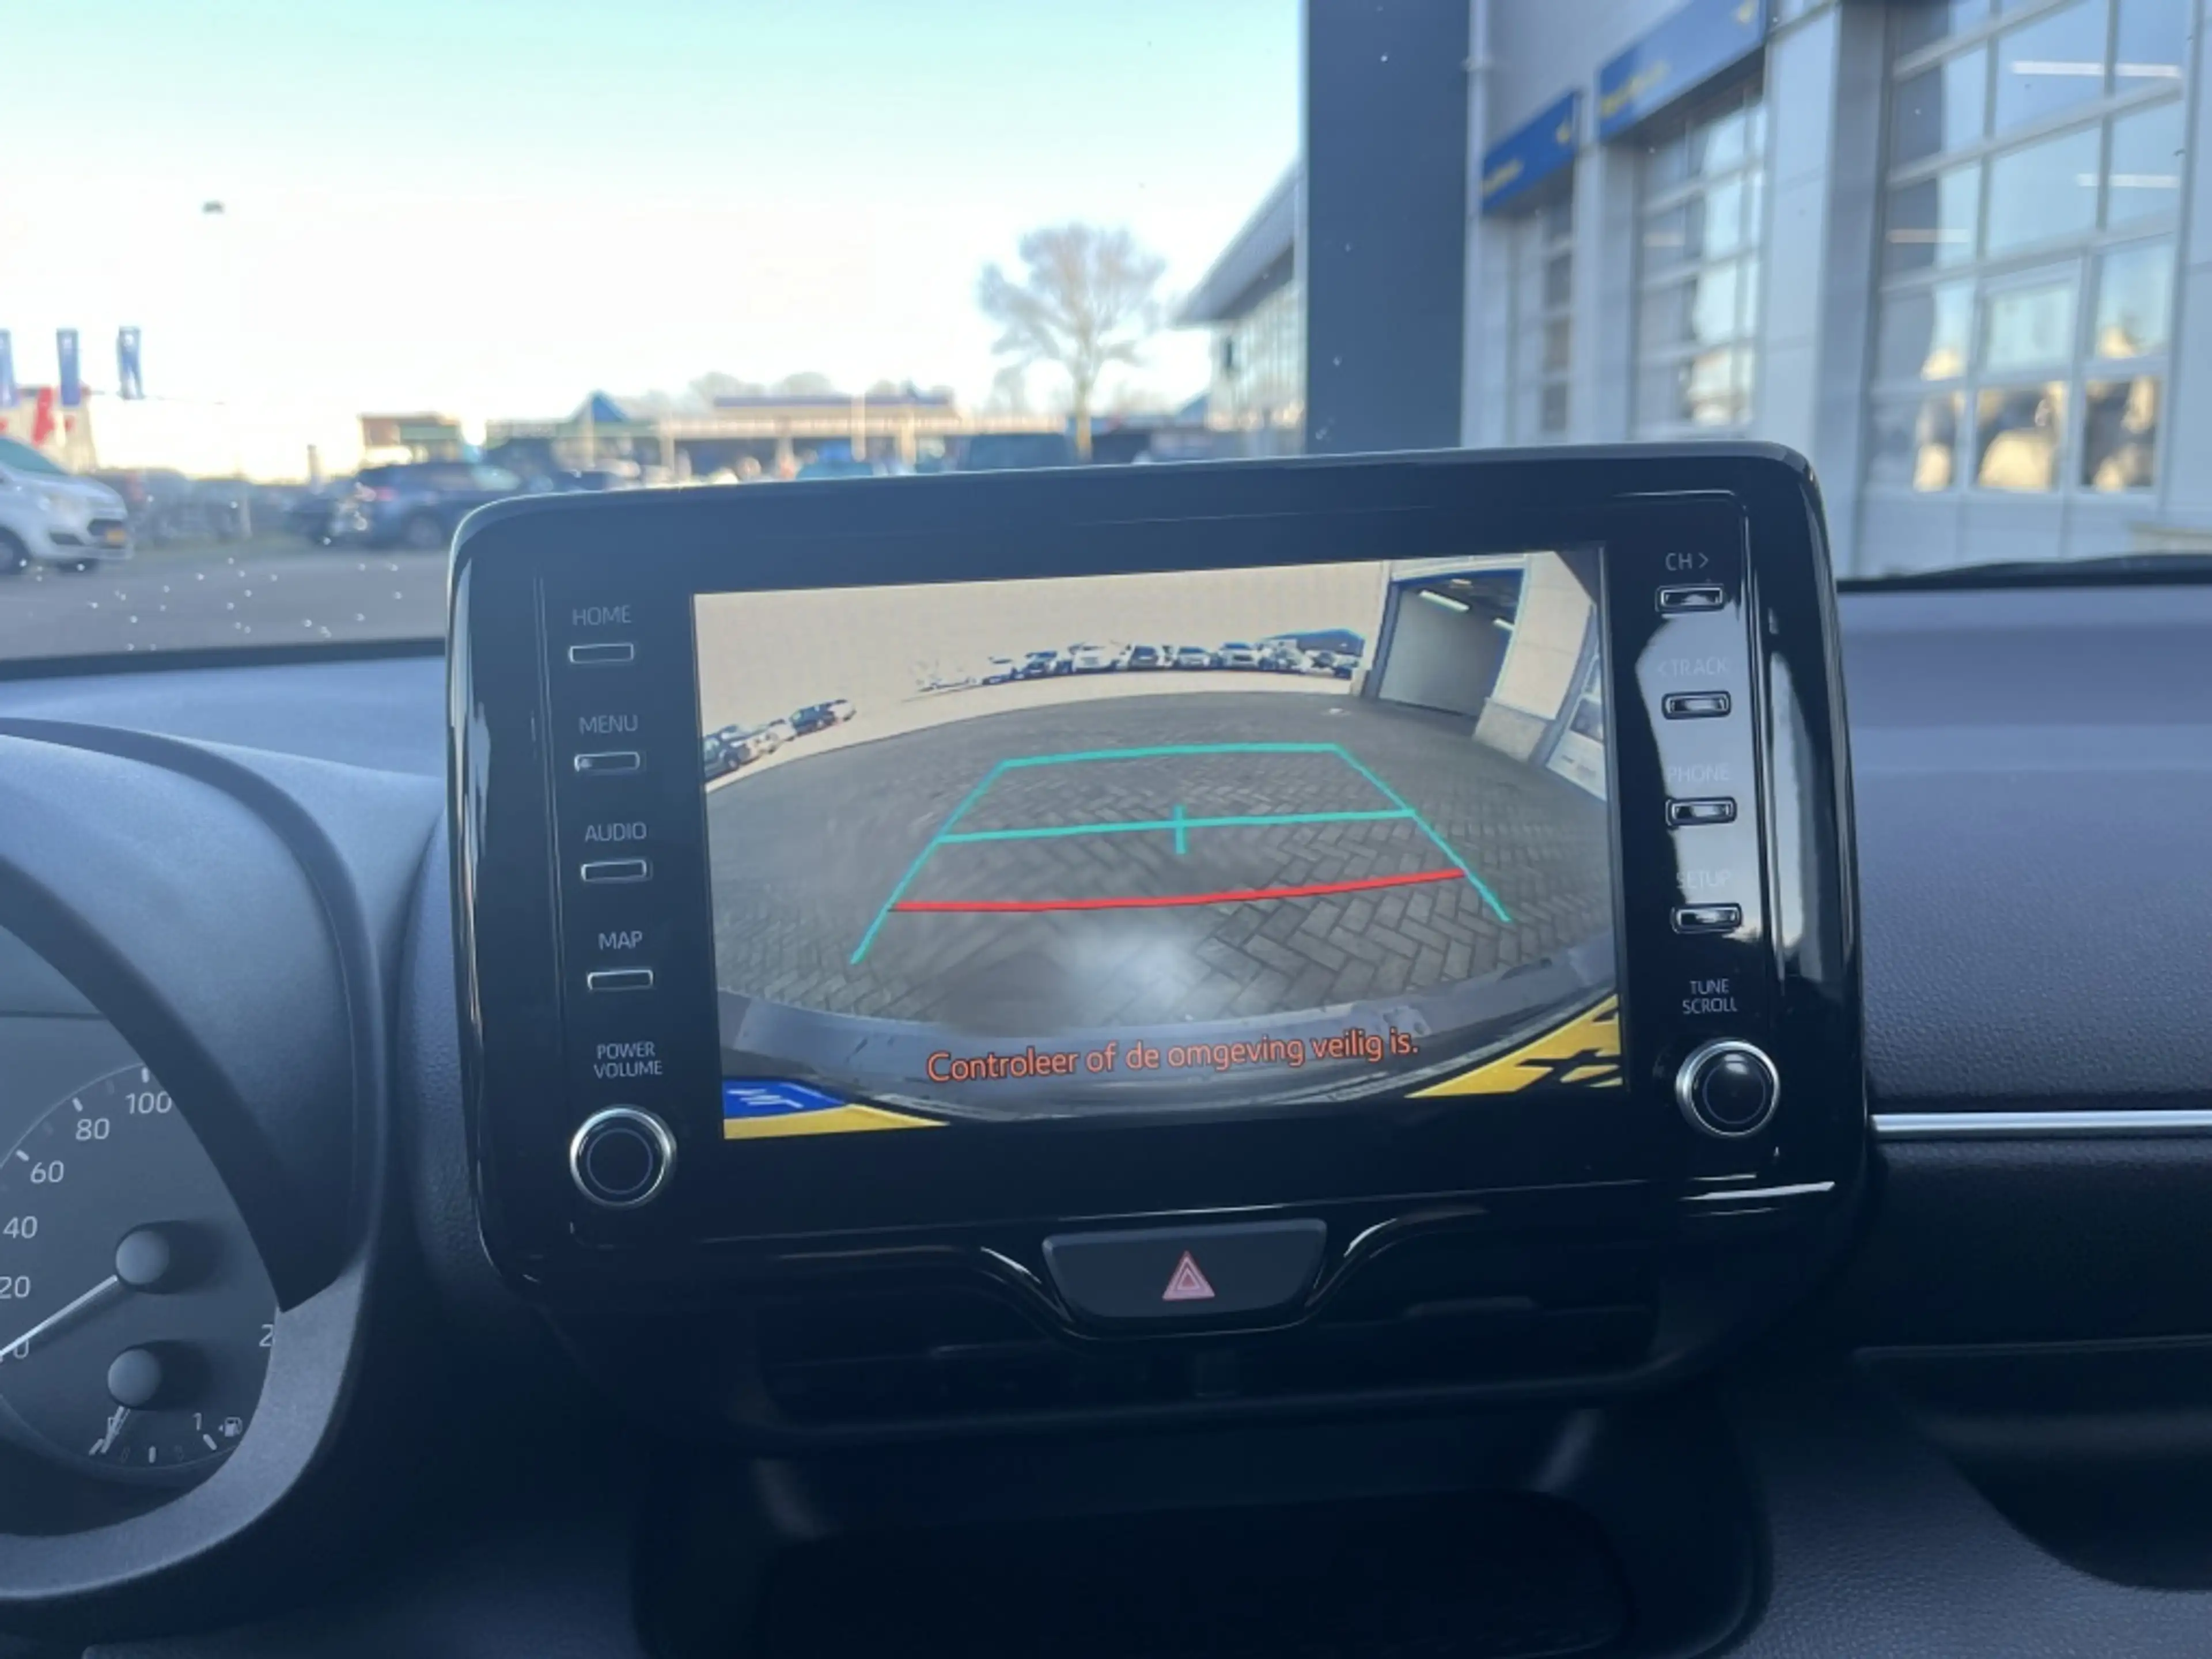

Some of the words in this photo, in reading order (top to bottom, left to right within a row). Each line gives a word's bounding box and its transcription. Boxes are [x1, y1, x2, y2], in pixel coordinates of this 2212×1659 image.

[573, 605, 632, 626] HOME
[579, 715, 638, 733] MENU
[1667, 764, 1733, 782] PHONE
[585, 822, 647, 842] AUDIO
[599, 931, 642, 950] MAP
[1690, 979, 1730, 995] TUNE
[1683, 998, 1737, 1014] SCROLL
[597, 1042, 655, 1059] POWER
[928, 1045, 1080, 1082] Controleer
[1086, 1040, 1118, 1072] of
[1126, 1040, 1160, 1070] de
[1168, 1035, 1304, 1071] omgeving
[1311, 1028, 1382, 1061] veilig
[1389, 1028, 1418, 1054] is.
[593, 1060, 663, 1078] VOLUME
[125, 1092, 172, 1114] 100
[75, 1119, 110, 1141] 80
[30, 1161, 65, 1183] 60
[3, 1215, 38, 1238] 40
[0, 1275, 31, 1298] 20
